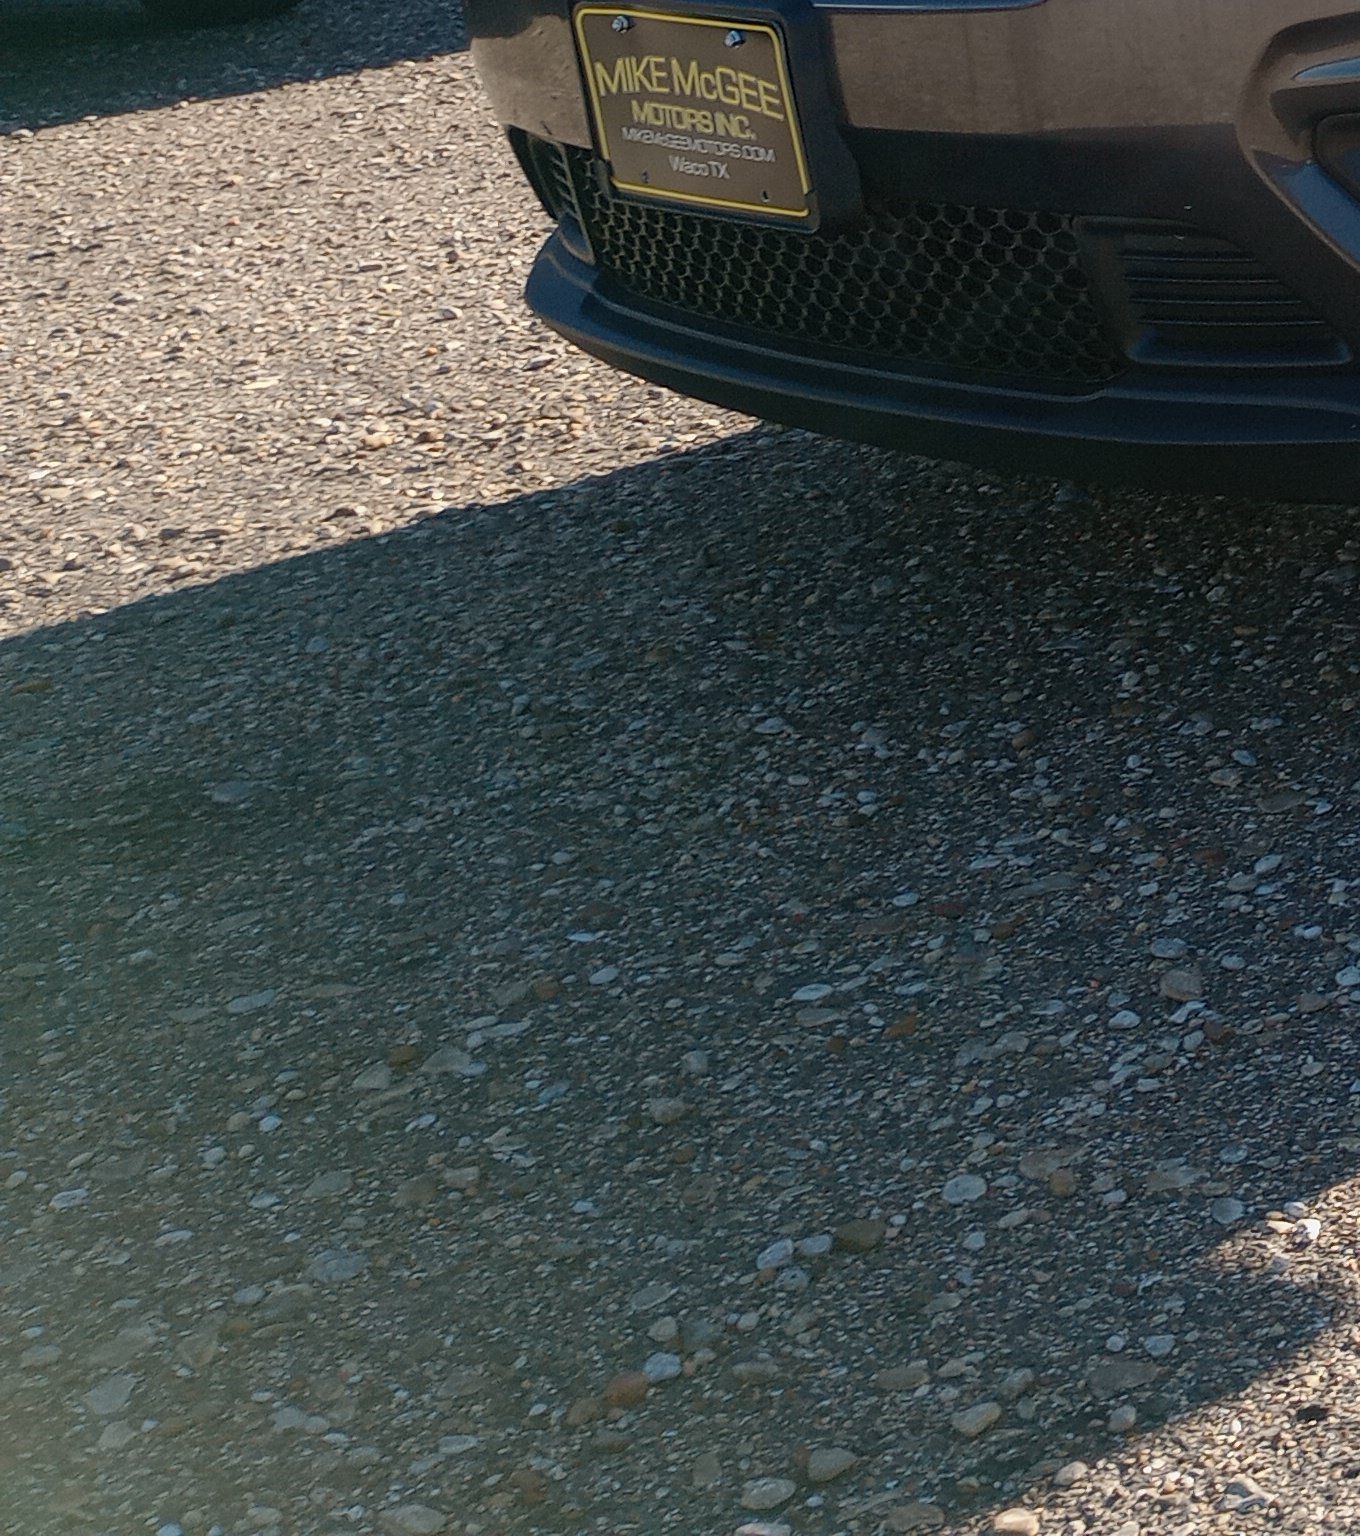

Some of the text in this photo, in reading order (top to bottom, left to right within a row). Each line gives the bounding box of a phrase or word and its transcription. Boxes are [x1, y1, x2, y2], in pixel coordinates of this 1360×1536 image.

[594, 55, 784, 121] MIKE McGEE
[631, 99, 757, 141] MOTORS INC.
[669, 154, 730, 179] Waco TX
